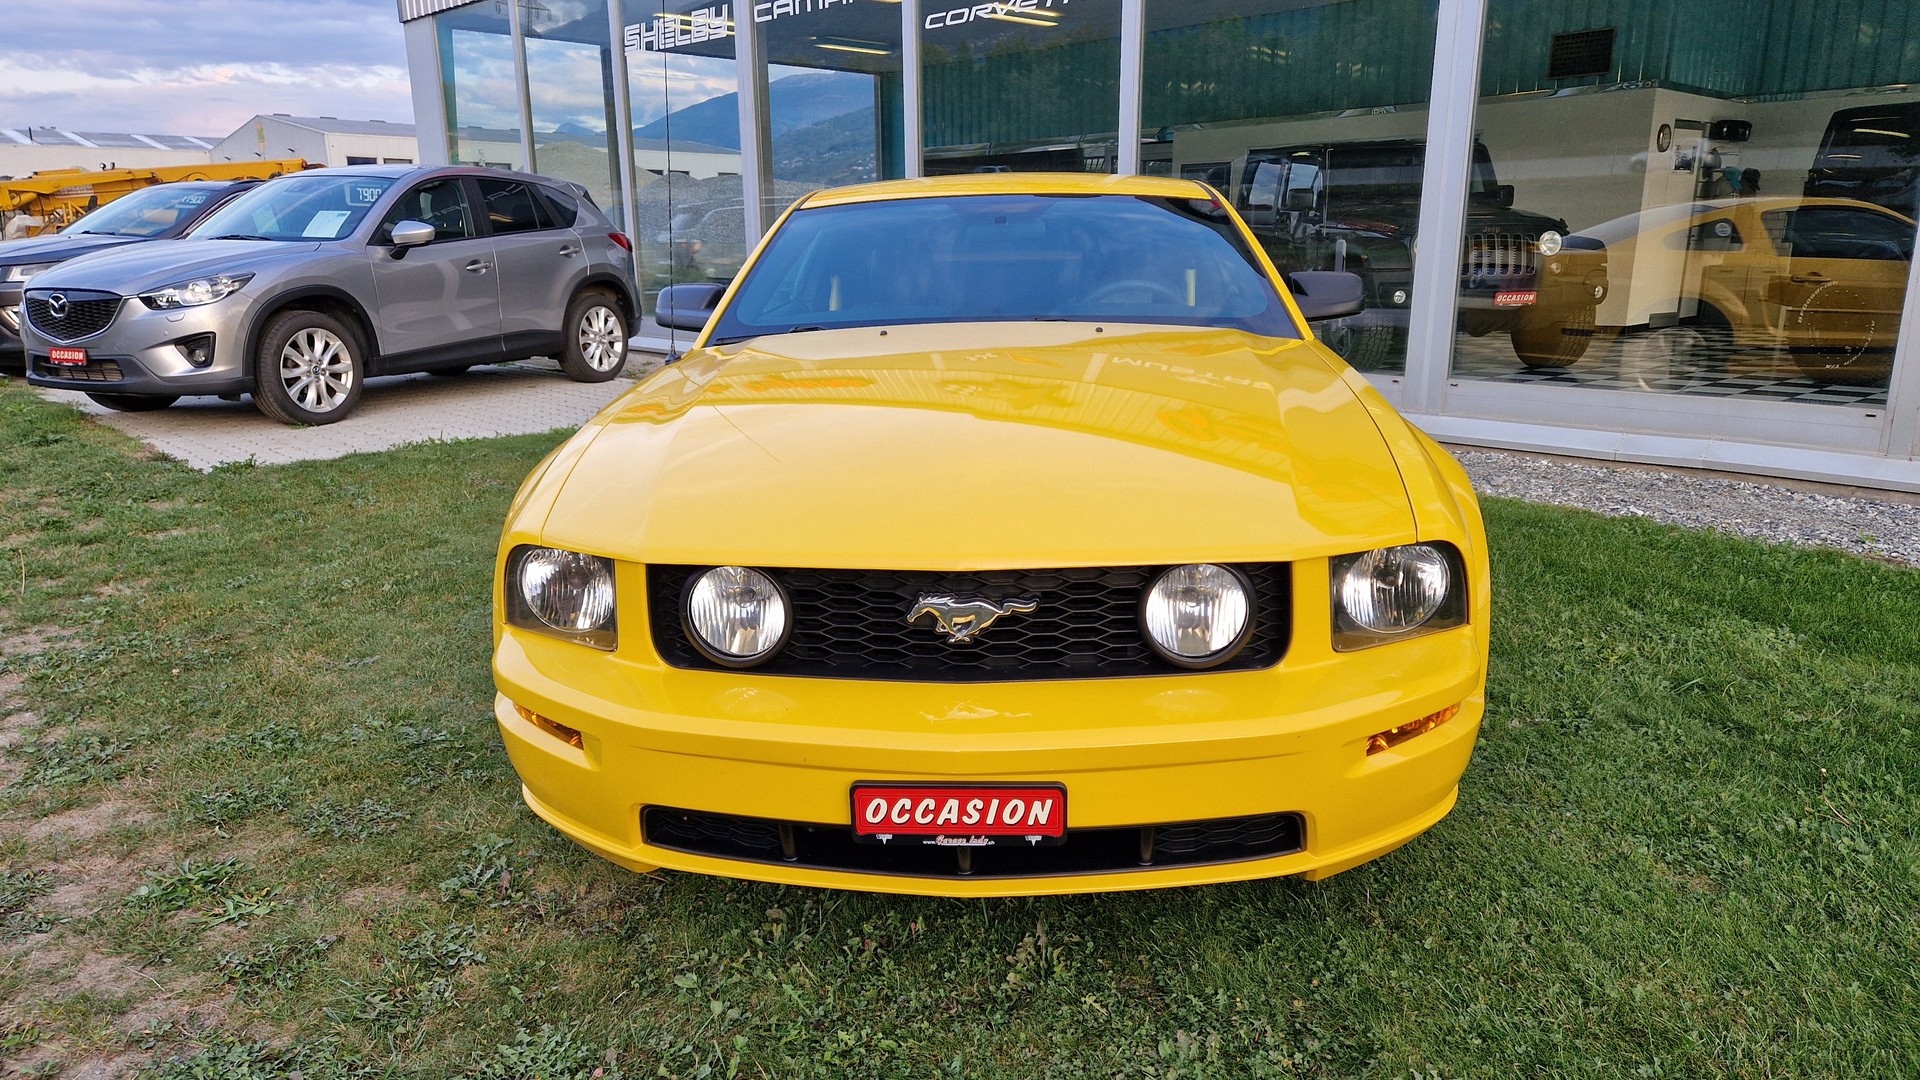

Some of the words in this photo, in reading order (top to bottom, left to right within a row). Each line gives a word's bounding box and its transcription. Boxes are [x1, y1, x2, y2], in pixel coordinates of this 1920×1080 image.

[753, 0, 855, 22] CAM
[924, 0, 1069, 29] CORVE
[624, 4, 728, 52] SHELBY
[356, 187, 382, 202] 7900
[1482, 225, 1501, 233] Jeep
[1496, 294, 1535, 302] OCCASION
[51, 350, 84, 360] OCCASION
[865, 797, 1053, 826] OCCASION
